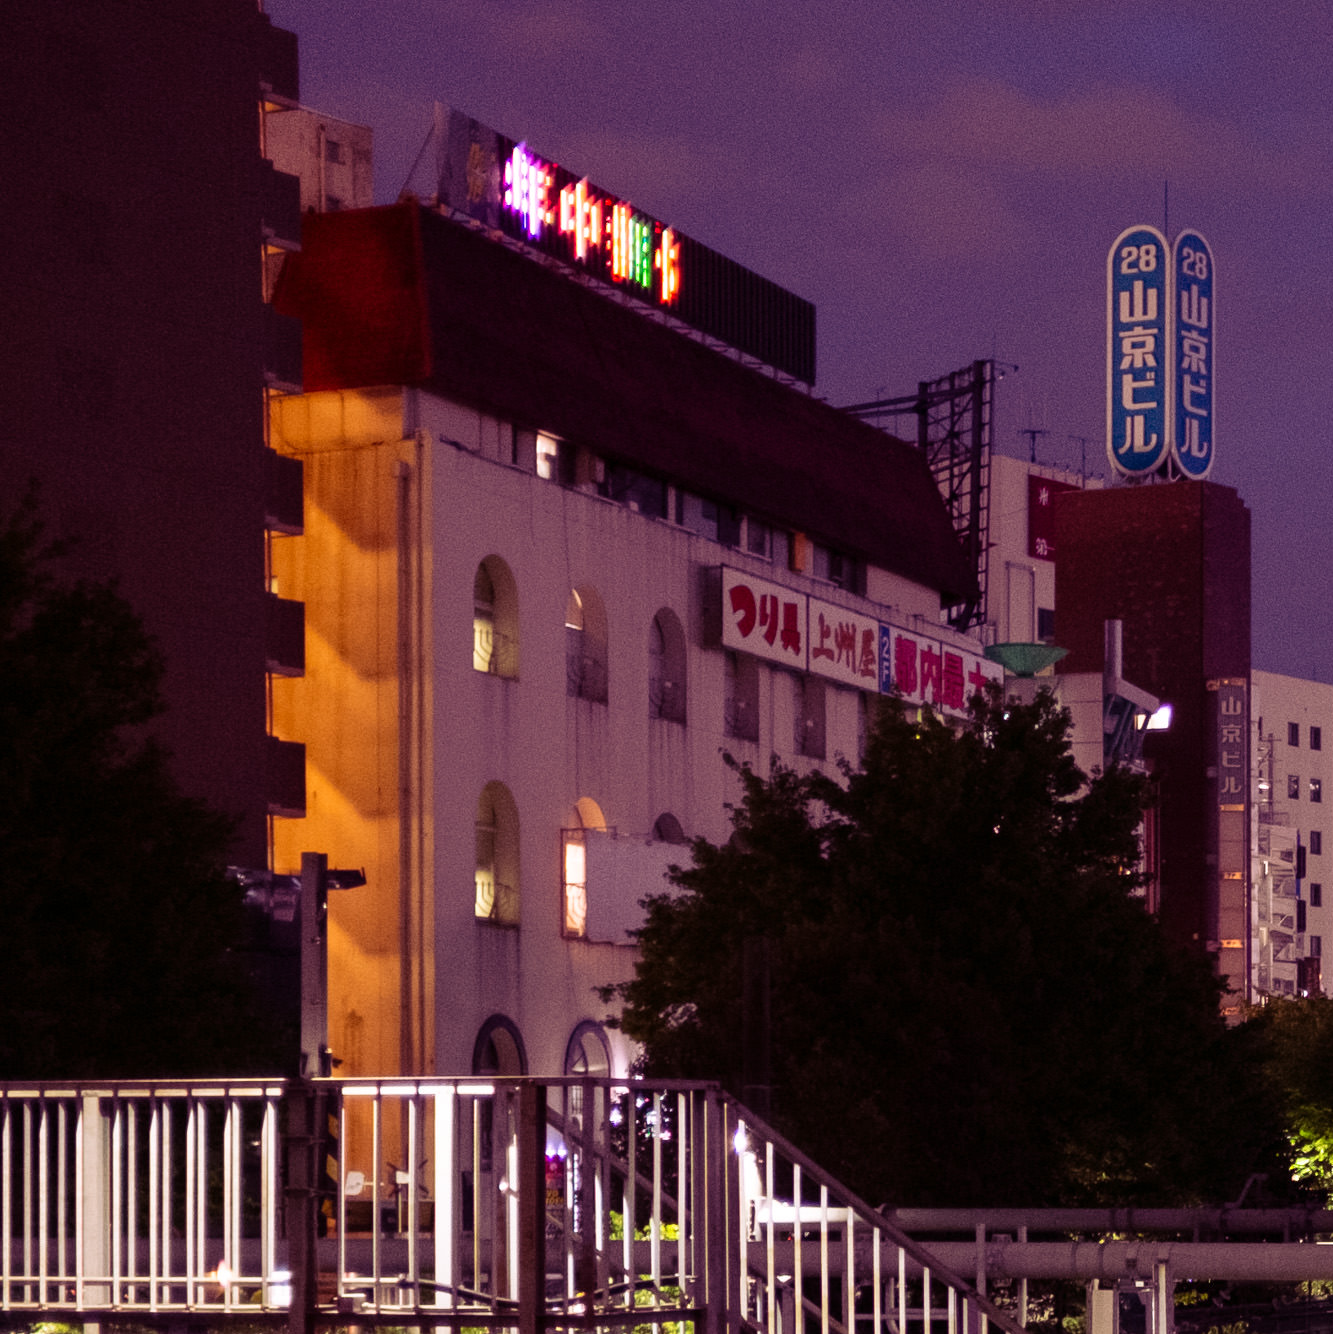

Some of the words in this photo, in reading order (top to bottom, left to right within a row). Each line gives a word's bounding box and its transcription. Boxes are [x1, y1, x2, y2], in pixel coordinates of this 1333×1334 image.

[729, 585, 801, 657] つり具
[812, 612, 876, 679] 上州屋
[1221, 696, 1242, 794] 山京ビル
